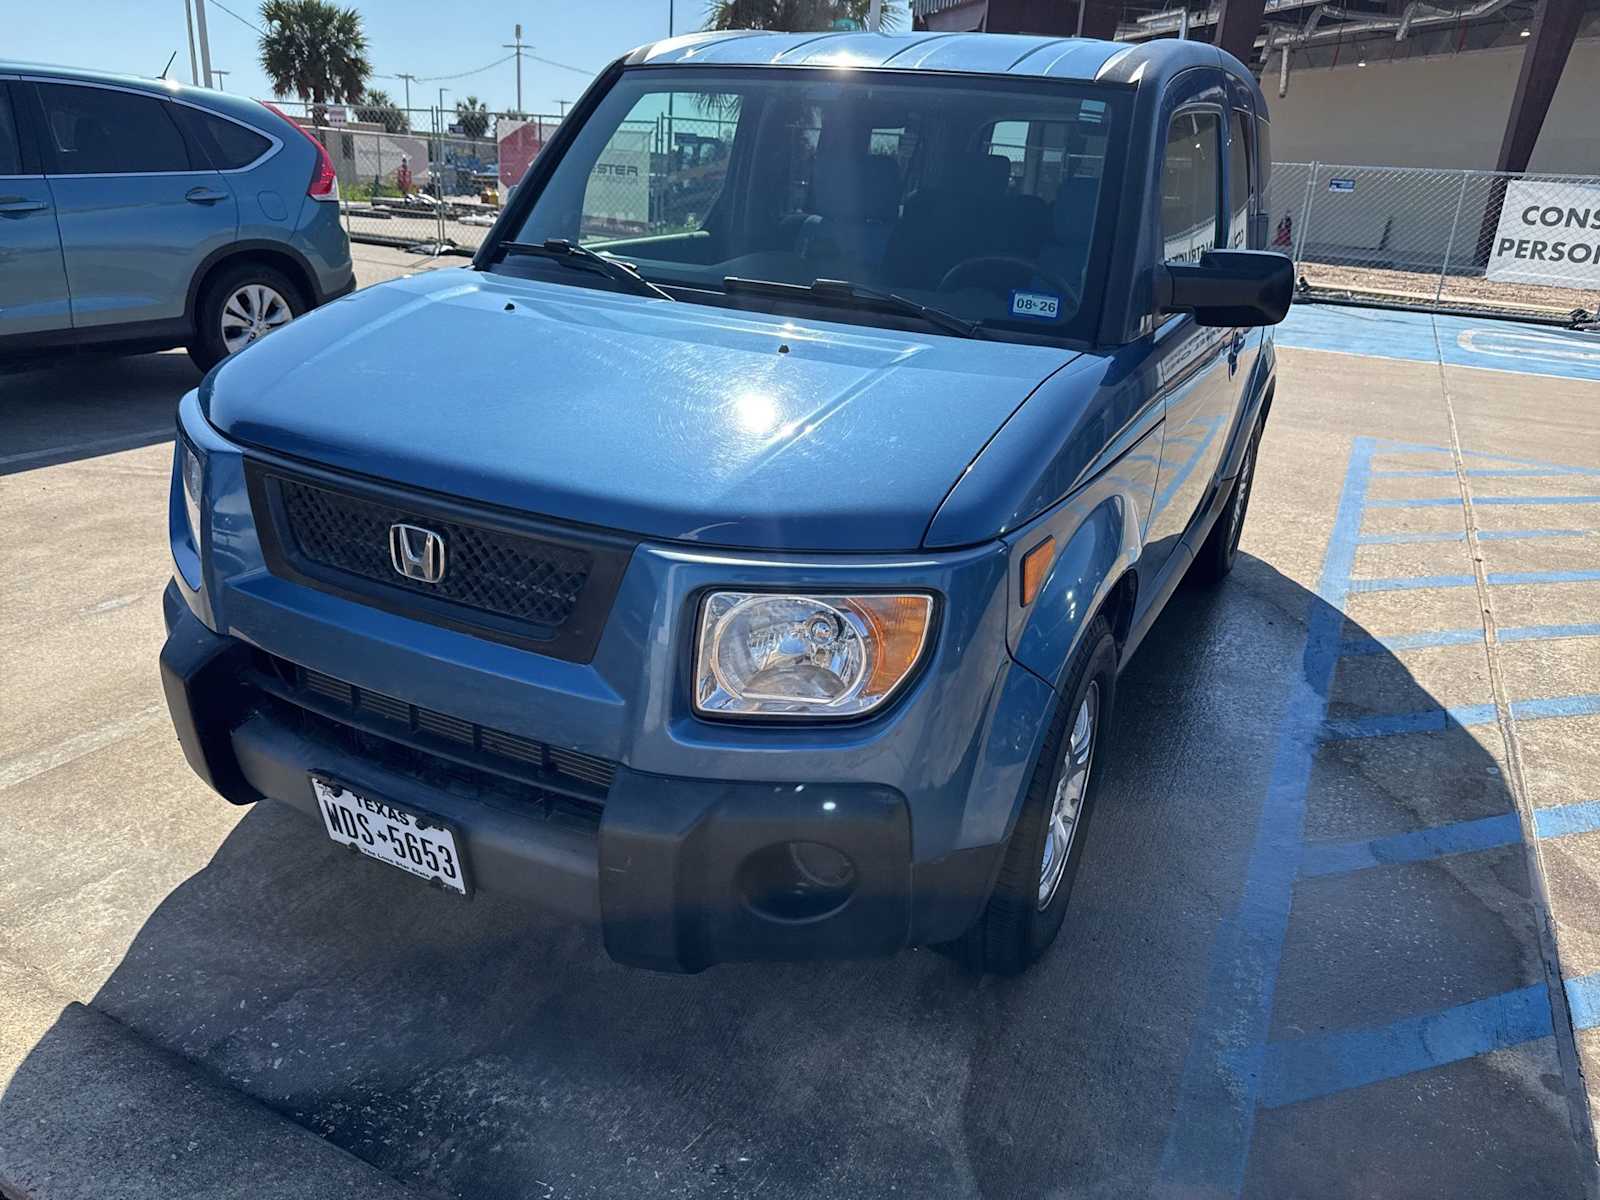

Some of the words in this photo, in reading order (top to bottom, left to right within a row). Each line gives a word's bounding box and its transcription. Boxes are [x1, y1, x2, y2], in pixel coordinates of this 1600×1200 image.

[1016, 298, 1033, 310] 08
[1040, 301, 1056, 313] 26
[353, 793, 410, 827] TEXAS
